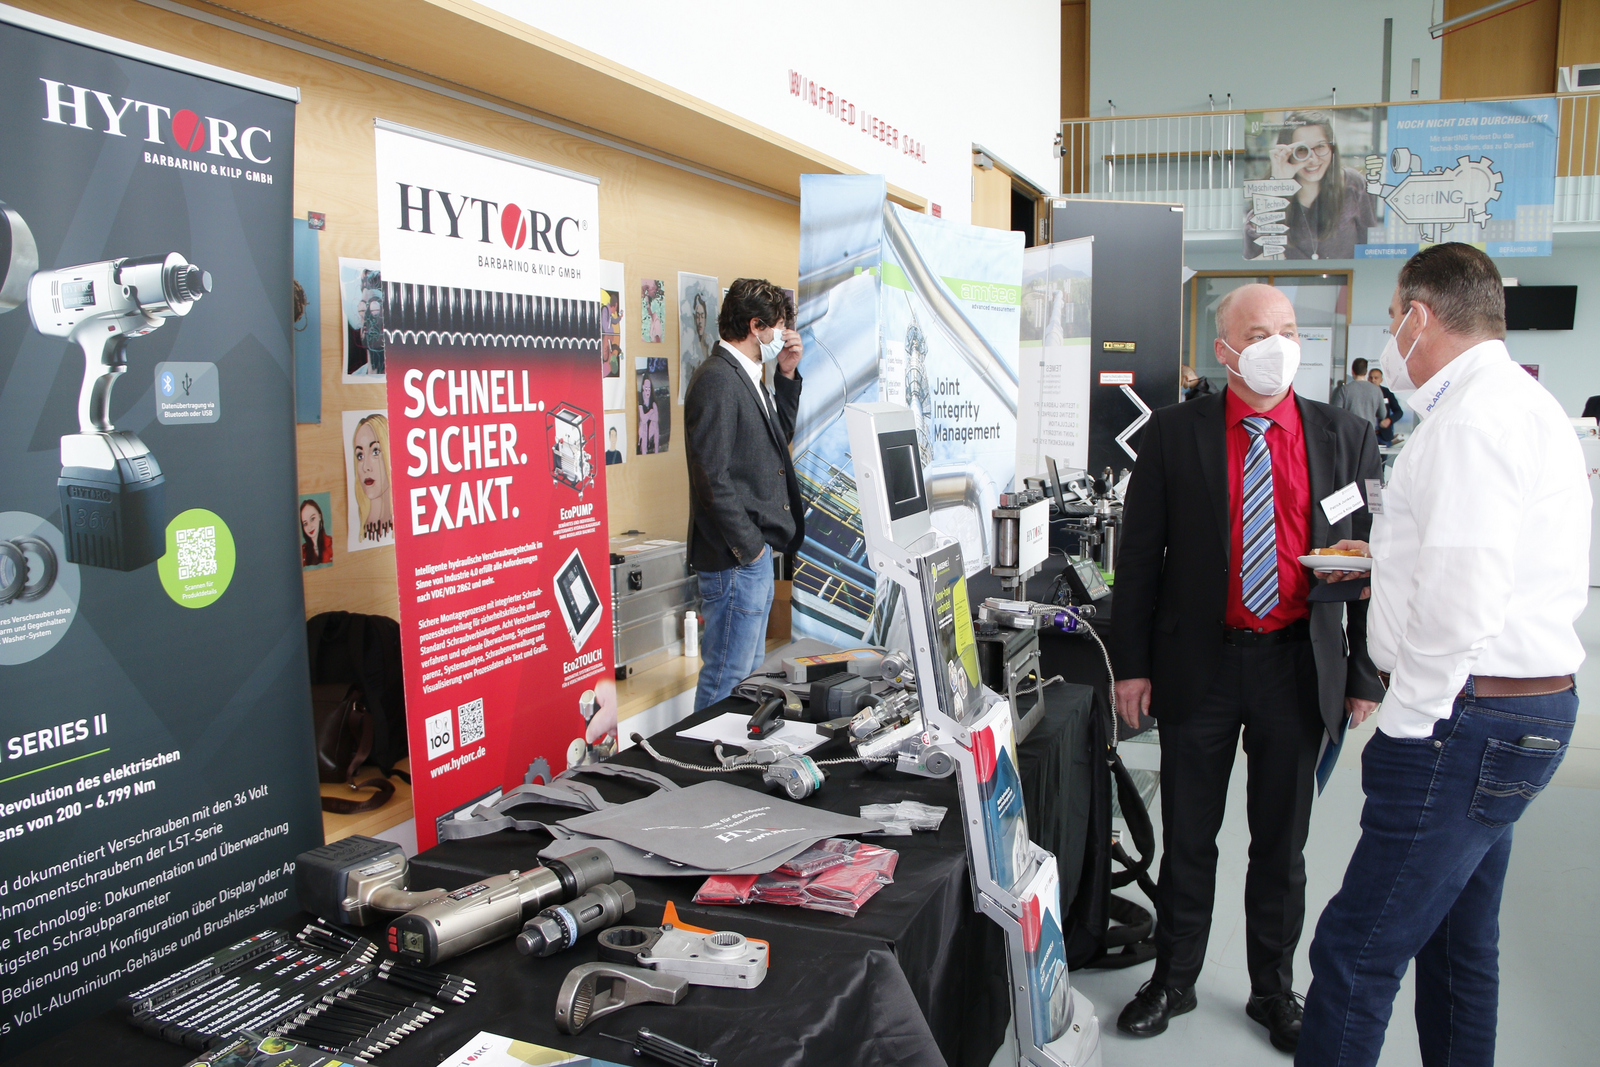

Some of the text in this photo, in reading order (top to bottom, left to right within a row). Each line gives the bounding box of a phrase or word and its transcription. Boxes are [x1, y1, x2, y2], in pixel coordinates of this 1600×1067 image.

[39, 77, 272, 165] HYTORC
[788, 69, 926, 164] WINFRIED LIEBER SAAL
[1397, 114, 1548, 129] NOCH NICHT DEN DURCHBLICK?
[144, 152, 273, 185] BARBARINO & KILP GMBH
[1247, 183, 1295, 194] Maschinenbau
[1404, 190, 1463, 205] startING
[478, 255, 581, 279] BARBARINO & KILP GMBH
[961, 283, 1017, 304] amtec
[404, 368, 545, 418] SCHNELL.
[933, 377, 960, 396] Joint
[1426, 380, 1450, 412] PLARAD
[161, 402, 206, 410] Datenübertragung
[934, 401, 980, 423] Integrity
[406, 422, 528, 478] SICHER.
[934, 424, 1000, 444] Management
[410, 476, 519, 536] EXAKT.
[560, 503, 593, 521] EcoPUMP
[415, 562, 447, 577] Intelligente
[448, 555, 482, 571] hydraulische
[482, 541, 537, 561] Verschraubungstechnik
[415, 555, 538, 590] Sinne von Industrie 4.0 erfüllt alle Anforderungen
[182, 589, 217, 600] Produktdetails
[184, 583, 204, 592] Scannen
[416, 592, 430, 603] nach
[456, 582, 471, 593] 2862
[472, 580, 481, 589] und
[482, 576, 495, 587] mehr.
[11, 607, 71, 624] Verschrauben ohne
[14, 617, 66, 633] und Gegenhalten
[418, 617, 439, 629] Sichere
[440, 603, 486, 623] Montageprozesse
[495, 593, 521, 608] integrierter
[522, 588, 542, 599] Schraub-
[419, 622, 472, 644] prozessbeurteilung
[481, 604, 525, 625] sicherheitskritische
[526, 601, 535, 610] und
[2, 629, 52, 644] Washer-System
[420, 642, 445, 655] Standard
[502, 619, 513, 629] Acht
[513, 609, 551, 626] Verschraubungs-
[485, 637, 535, 660] Schraubenverwaltung
[536, 633, 545, 642] und
[421, 654, 448, 668] verfahren
[449, 649, 460, 659] und
[461, 642, 483, 656] optimale
[423, 643, 548, 694] Visualisierung von Prozessdaten als Text und Grafik.
[563, 648, 602, 674] Eco2TOUCH
[8, 713, 108, 760] SERIES II
[430, 732, 450, 750] 100
[76, 776, 100, 793] des
[103, 750, 181, 784] elektrischen
[430, 746, 486, 779] www.hytorc.de
[27, 814, 53, 832] von
[56, 802, 82, 822] 200
[96, 785, 131, 808] 6.799
[134, 779, 156, 797] Nm
[13, 846, 106, 891] dokumentiert
[108, 816, 189, 854] Verschrauben
[192, 806, 210, 822] mit
[212, 799, 232, 815] den
[234, 791, 247, 807] 36
[248, 784, 269, 802] Volt
[0, 822, 223, 920] hmomentschraubern der LST-Serie
[14, 899, 102, 943] Technologie:
[105, 860, 195, 905] Dokumentation
[197, 848, 217, 868] und
[219, 821, 289, 858] Überwachung
[2, 867, 280, 1004] Bedienung und Konfiguration über Display oder
[52, 890, 171, 951] Schraubparameter
[14, 887, 289, 1027] Voll-Aluminium-Gehäuse und Brushless-Motor
